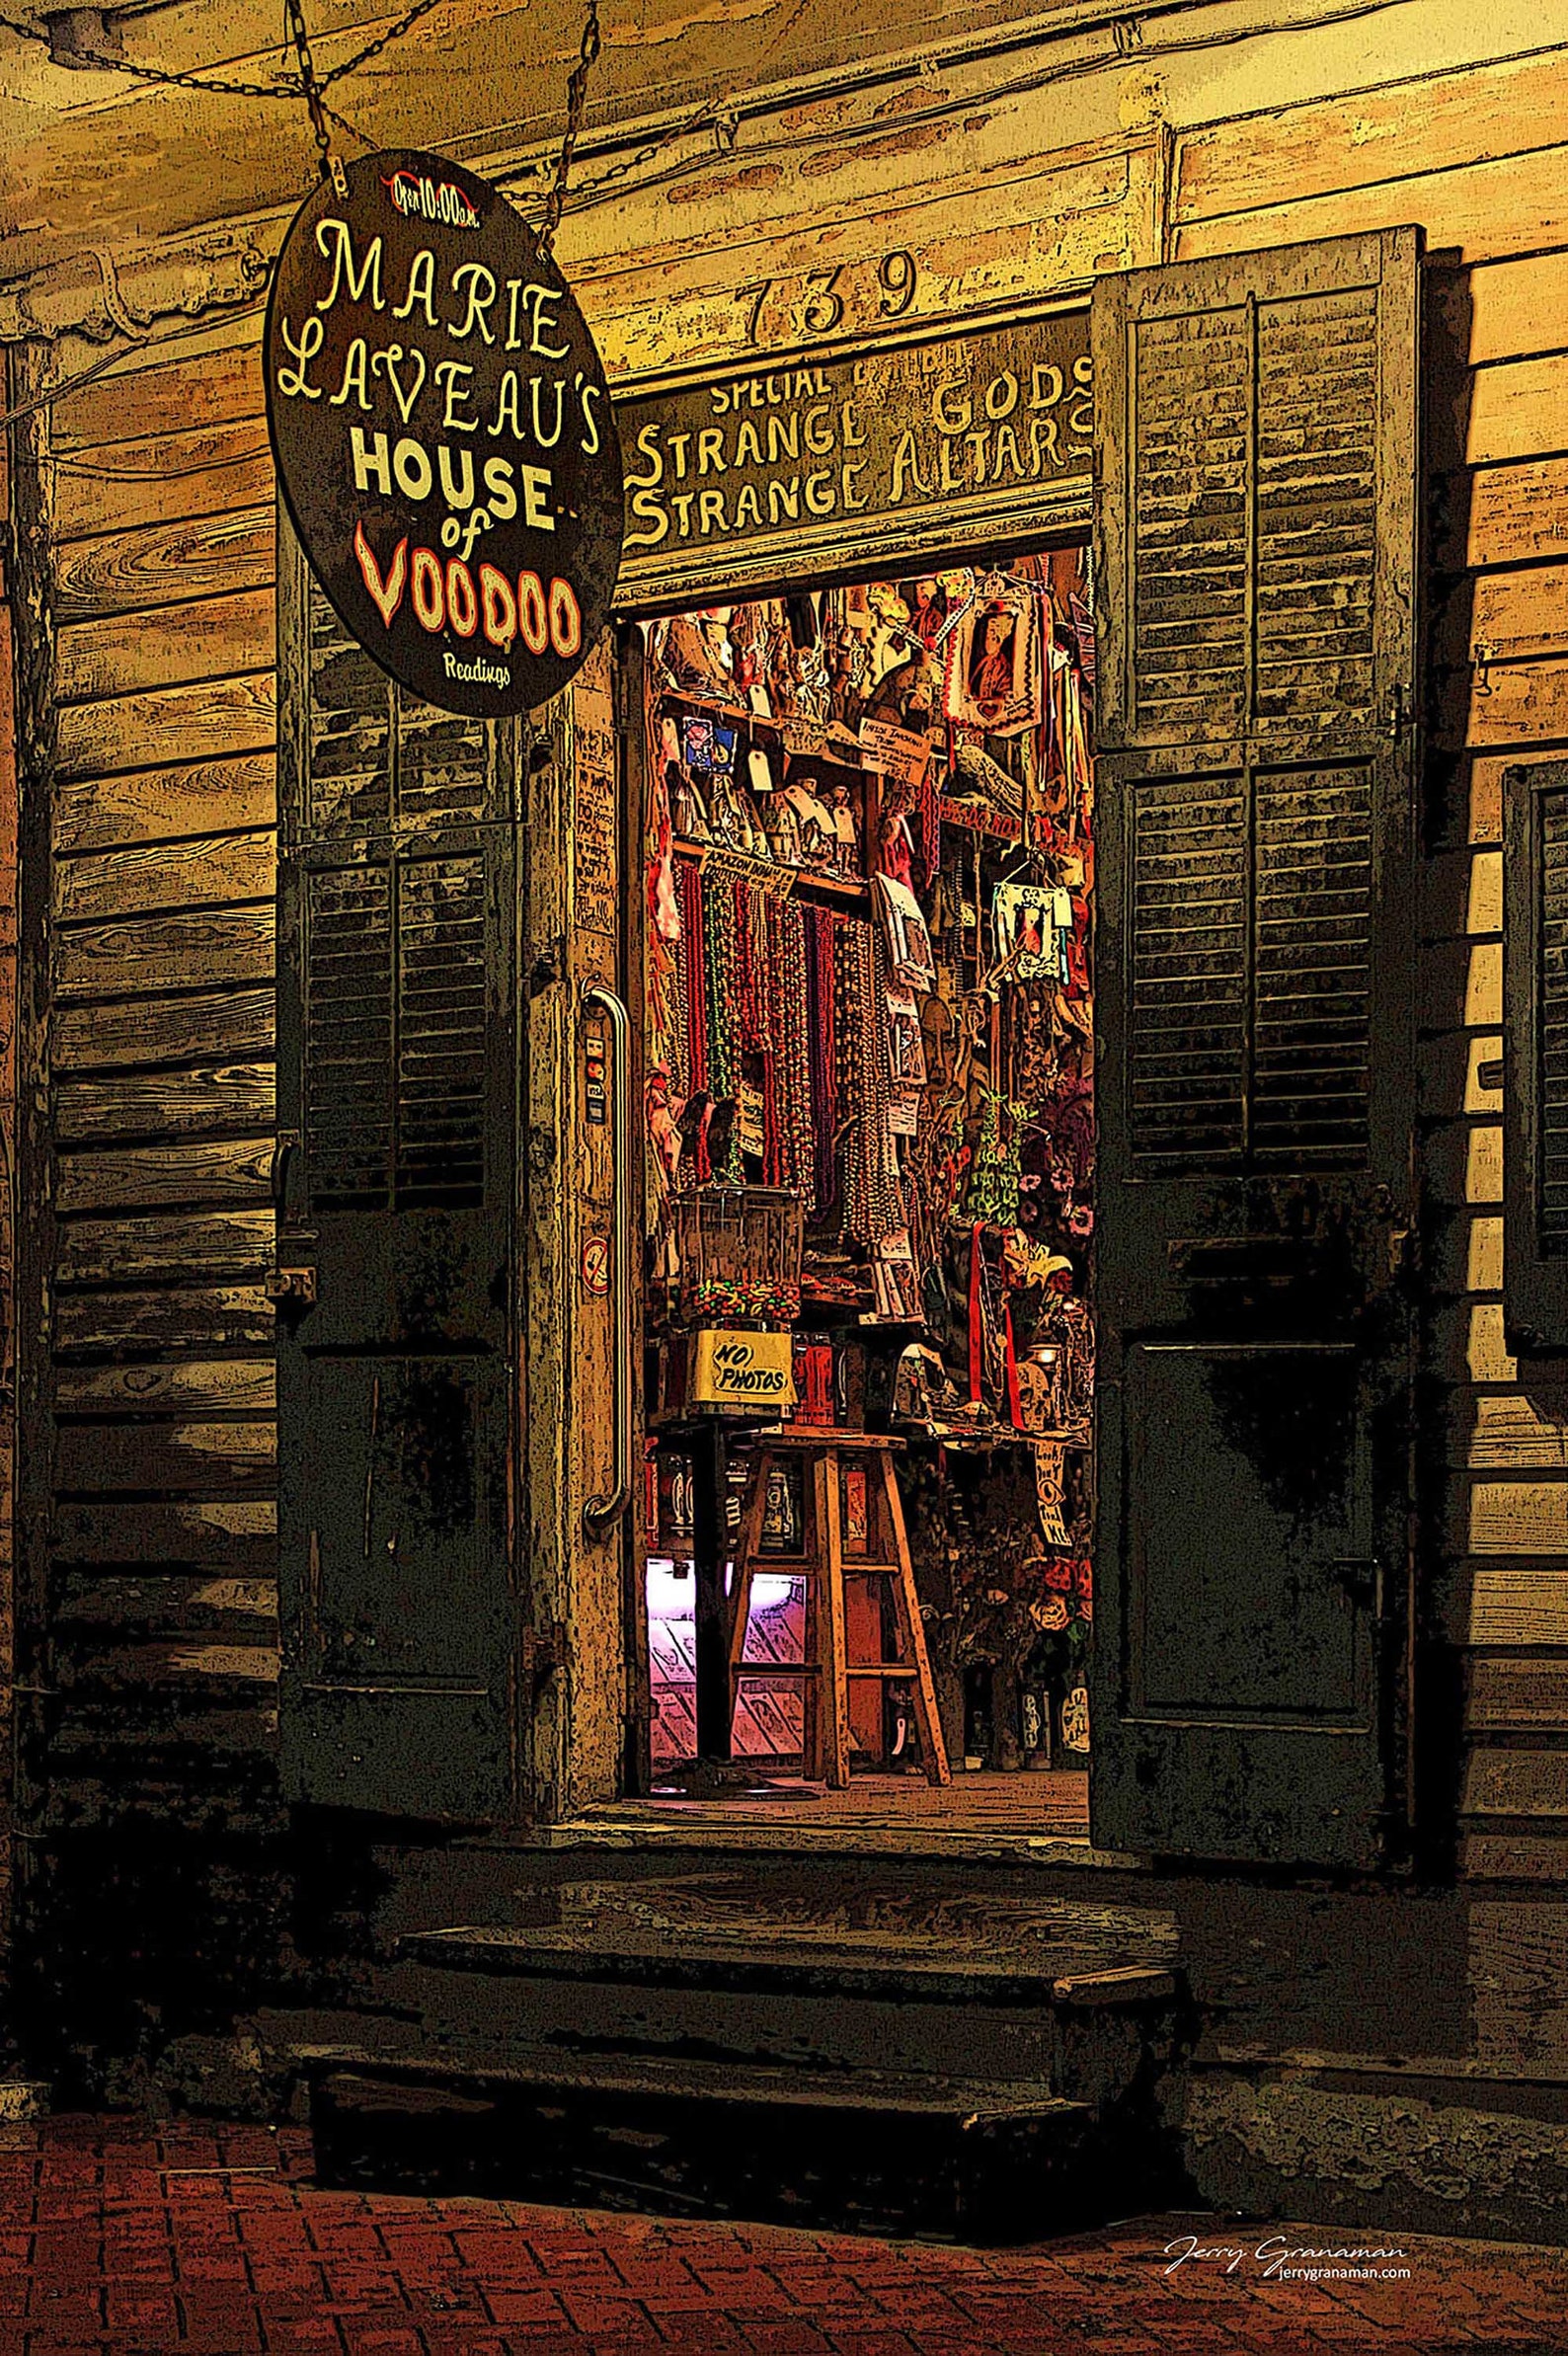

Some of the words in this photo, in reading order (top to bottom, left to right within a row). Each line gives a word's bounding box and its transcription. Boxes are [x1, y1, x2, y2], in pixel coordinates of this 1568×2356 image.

[316, 219, 571, 359] MARIE
[734, 250, 919, 345] 739
[277, 314, 601, 455] LAVEAU'S
[710, 366, 832, 414] SPECIAL
[350, 426, 557, 531] HOUSE
[624, 399, 868, 491] STRANGE
[440, 508, 494, 561] of
[622, 459, 871, 549] STRANGE
[353, 519, 583, 659] VOODOO
[442, 652, 511, 689] Readings
[715, 1344, 748, 1366] NO
[718, 1368, 785, 1391] PHOTOS
